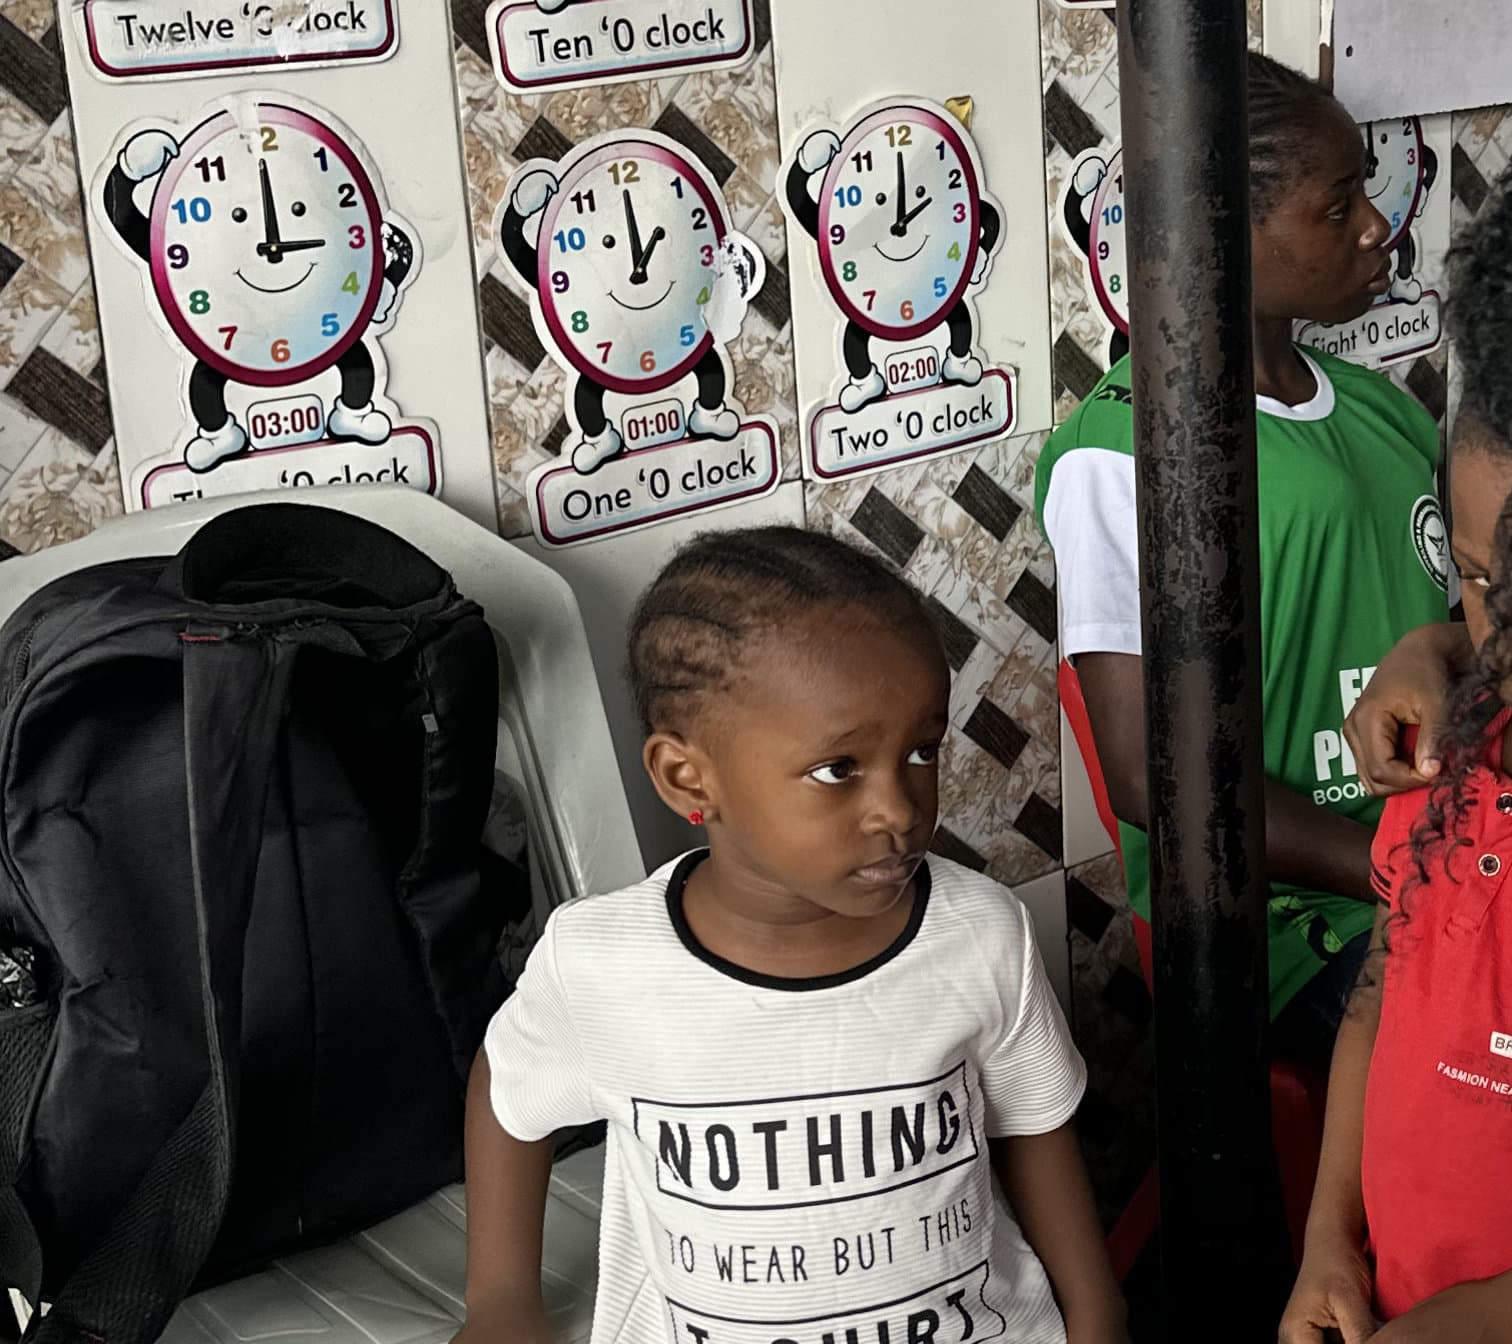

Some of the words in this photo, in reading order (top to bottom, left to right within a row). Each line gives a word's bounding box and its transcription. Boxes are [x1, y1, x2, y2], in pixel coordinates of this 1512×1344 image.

[118, 11, 233, 46] Twelve
[529, 28, 592, 64] Ten
[646, 8, 725, 47] clock
[885, 125, 912, 147] 12
[1403, 118, 1411, 136] 2
[314, 147, 328, 172] 1
[851, 151, 872, 172] 11
[936, 141, 944, 160] 1
[1407, 148, 1415, 165] 3
[195, 156, 225, 182] 11
[608, 161, 640, 185] 12
[949, 169, 961, 189] 2
[338, 183, 357, 208] 2
[671, 177, 683, 199] 1
[835, 185, 861, 208] 10
[1403, 182, 1411, 198] 4
[172, 197, 211, 224] 10
[570, 189, 595, 214] 11
[692, 208, 707, 230] 2
[953, 203, 966, 223] 3
[1102, 205, 1122, 226] 10
[1393, 213, 1400, 228] 5
[348, 225, 365, 249] 3
[554, 228, 585, 253] 10
[830, 225, 845, 245] 9
[167, 244, 189, 269] 9
[701, 245, 713, 267] 3
[947, 242, 961, 261] 4
[1098, 241, 1109, 260] 9
[552, 271, 569, 293] 9
[843, 261, 857, 282] 8
[341, 272, 360, 295] 4
[934, 277, 947, 297] 5
[1110, 274, 1121, 293] 8
[189, 290, 210, 314] 8
[863, 290, 876, 311] 7
[900, 300, 914, 320] 6
[322, 313, 340, 336] 5
[571, 311, 589, 333] 8
[1386, 309, 1430, 339] clock
[219, 326, 238, 350] 7
[680, 325, 695, 346] 5
[271, 339, 290, 363] 6
[597, 342, 612, 364] 7
[640, 351, 656, 372] 6
[889, 357, 937, 385] 02:00
[251, 406, 320, 439] 03:00
[628, 410, 680, 440] 01:00
[832, 427, 888, 456] Two
[933, 396, 993, 432] clock
[562, 488, 631, 522] One
[681, 448, 757, 492] clock
[658, 1089, 961, 1191] NOTHING
[667, 1228, 695, 1274] TO
[713, 1243, 809, 1284] WEAR
[834, 1226, 895, 1276] BUT
[919, 1198, 972, 1253] THIS
